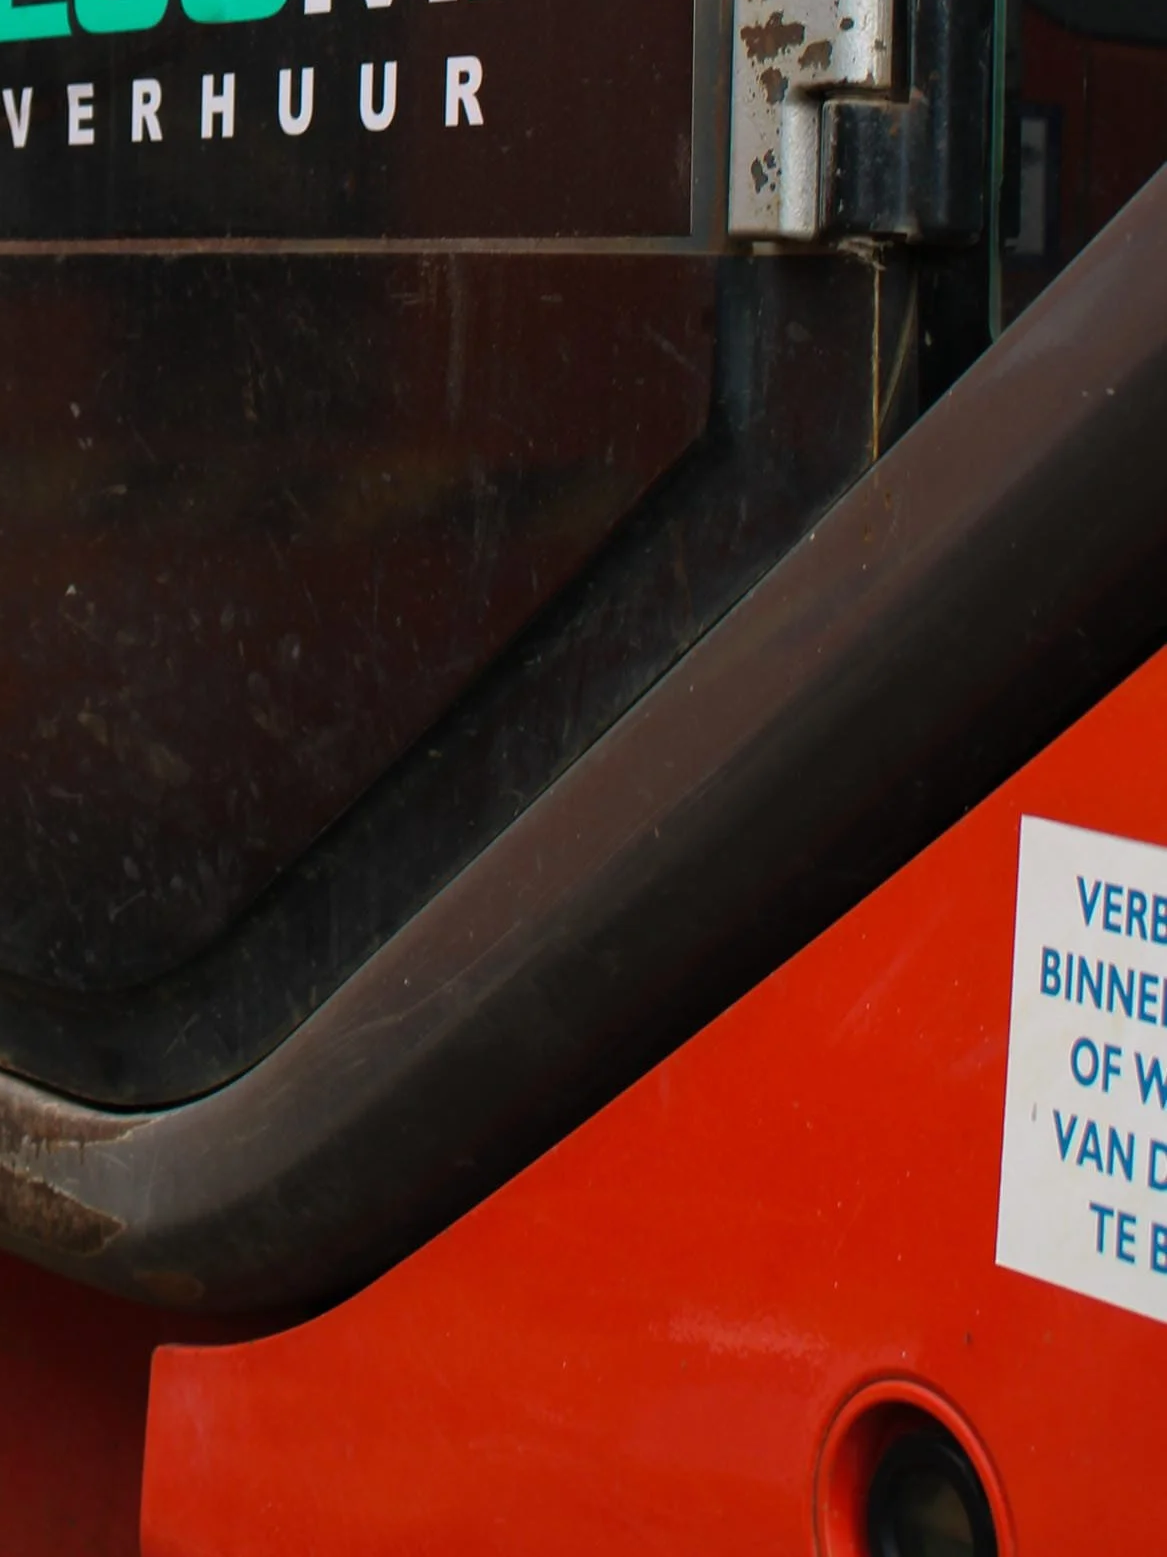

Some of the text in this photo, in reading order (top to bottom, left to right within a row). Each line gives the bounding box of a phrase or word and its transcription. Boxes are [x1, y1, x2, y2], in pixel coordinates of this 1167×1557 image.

[2, 54, 485, 149] VERHUUR
[1040, 945, 1167, 1029] BINNE
[1071, 1036, 1122, 1092] OF
[1053, 1108, 1135, 1182] VAN
[1089, 1201, 1136, 1264] TE
